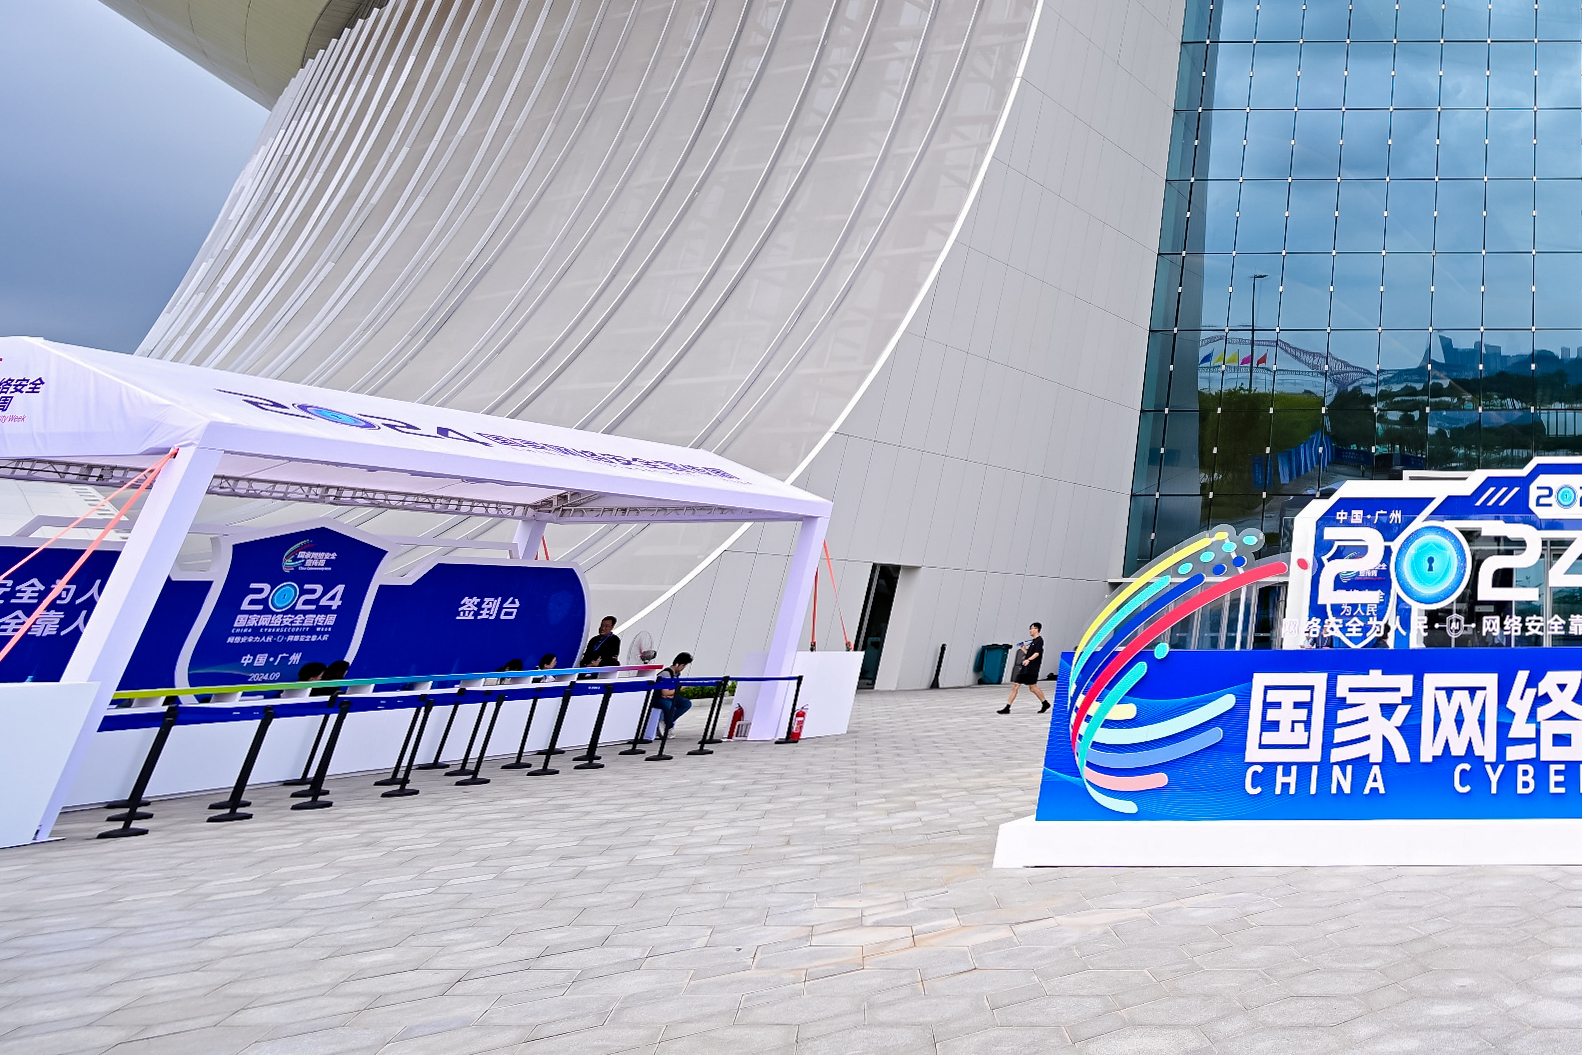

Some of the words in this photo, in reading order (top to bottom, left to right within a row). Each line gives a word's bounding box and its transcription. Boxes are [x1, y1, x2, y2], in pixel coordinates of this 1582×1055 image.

[240, 582, 346, 612] 2024
[455, 597, 520, 619] 签到台
[1340, 604, 1378, 616] 为人民
[233, 614, 337, 627] 国家网络安全宣传周
[1282, 616, 1428, 637] 网络安全为人民
[248, 672, 280, 681] 2024.09
[1244, 764, 1386, 795] CHINA
